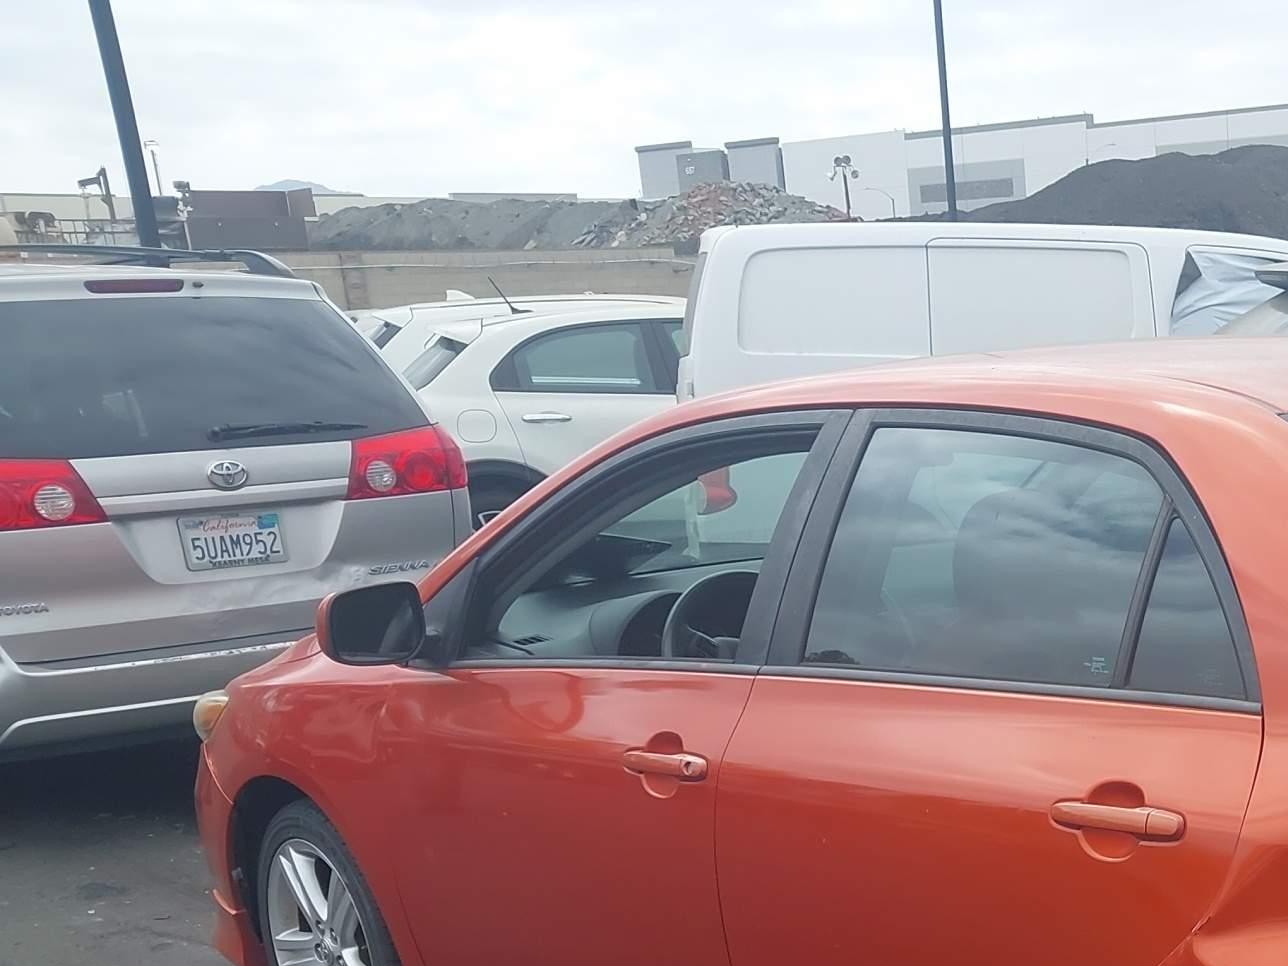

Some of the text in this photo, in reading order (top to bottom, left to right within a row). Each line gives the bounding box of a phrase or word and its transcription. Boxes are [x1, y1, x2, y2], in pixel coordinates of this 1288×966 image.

[202, 518, 256, 533] California
[191, 530, 281, 561] 5UAM952
[367, 559, 431, 576] SIENNA
